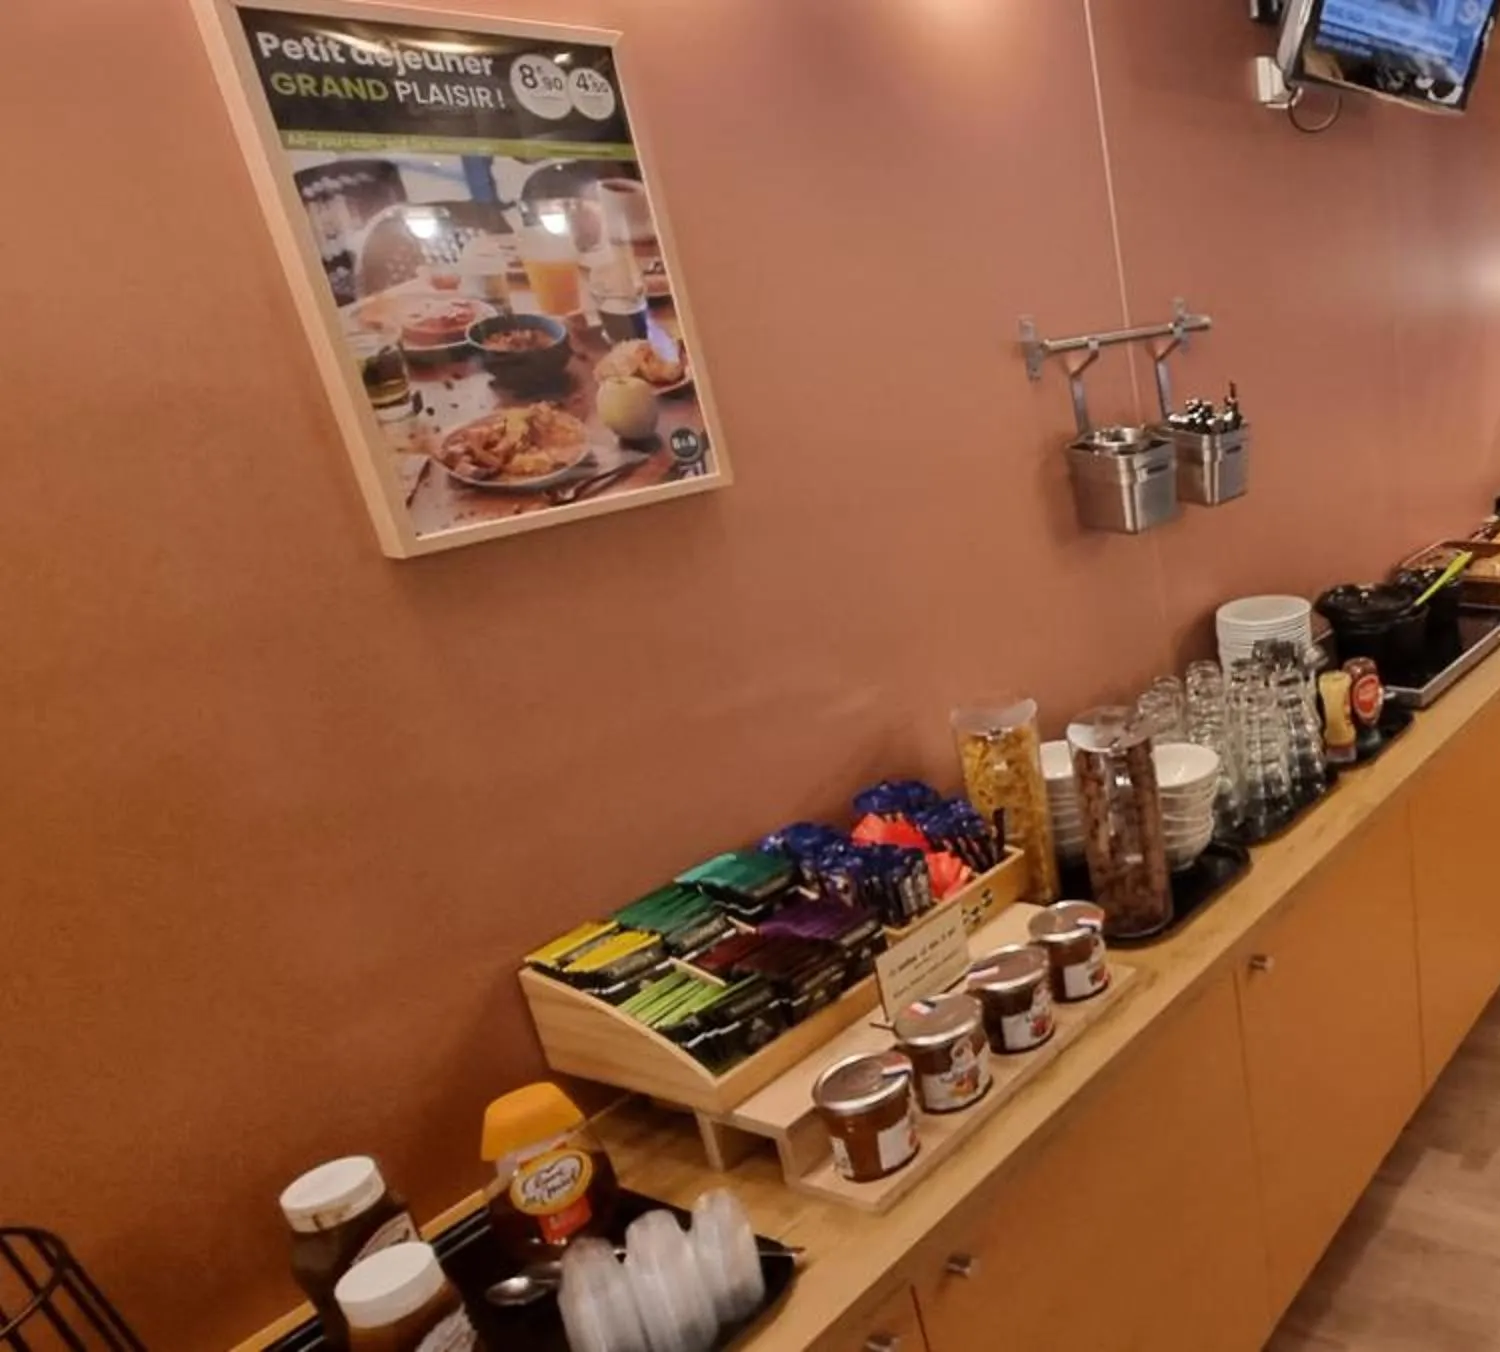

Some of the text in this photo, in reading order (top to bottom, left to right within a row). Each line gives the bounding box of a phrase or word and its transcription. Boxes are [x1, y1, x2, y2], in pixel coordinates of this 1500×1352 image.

[257, 31, 346, 64] Petit
[270, 72, 390, 101] GRAND
[394, 80, 494, 109] PLAISIR
